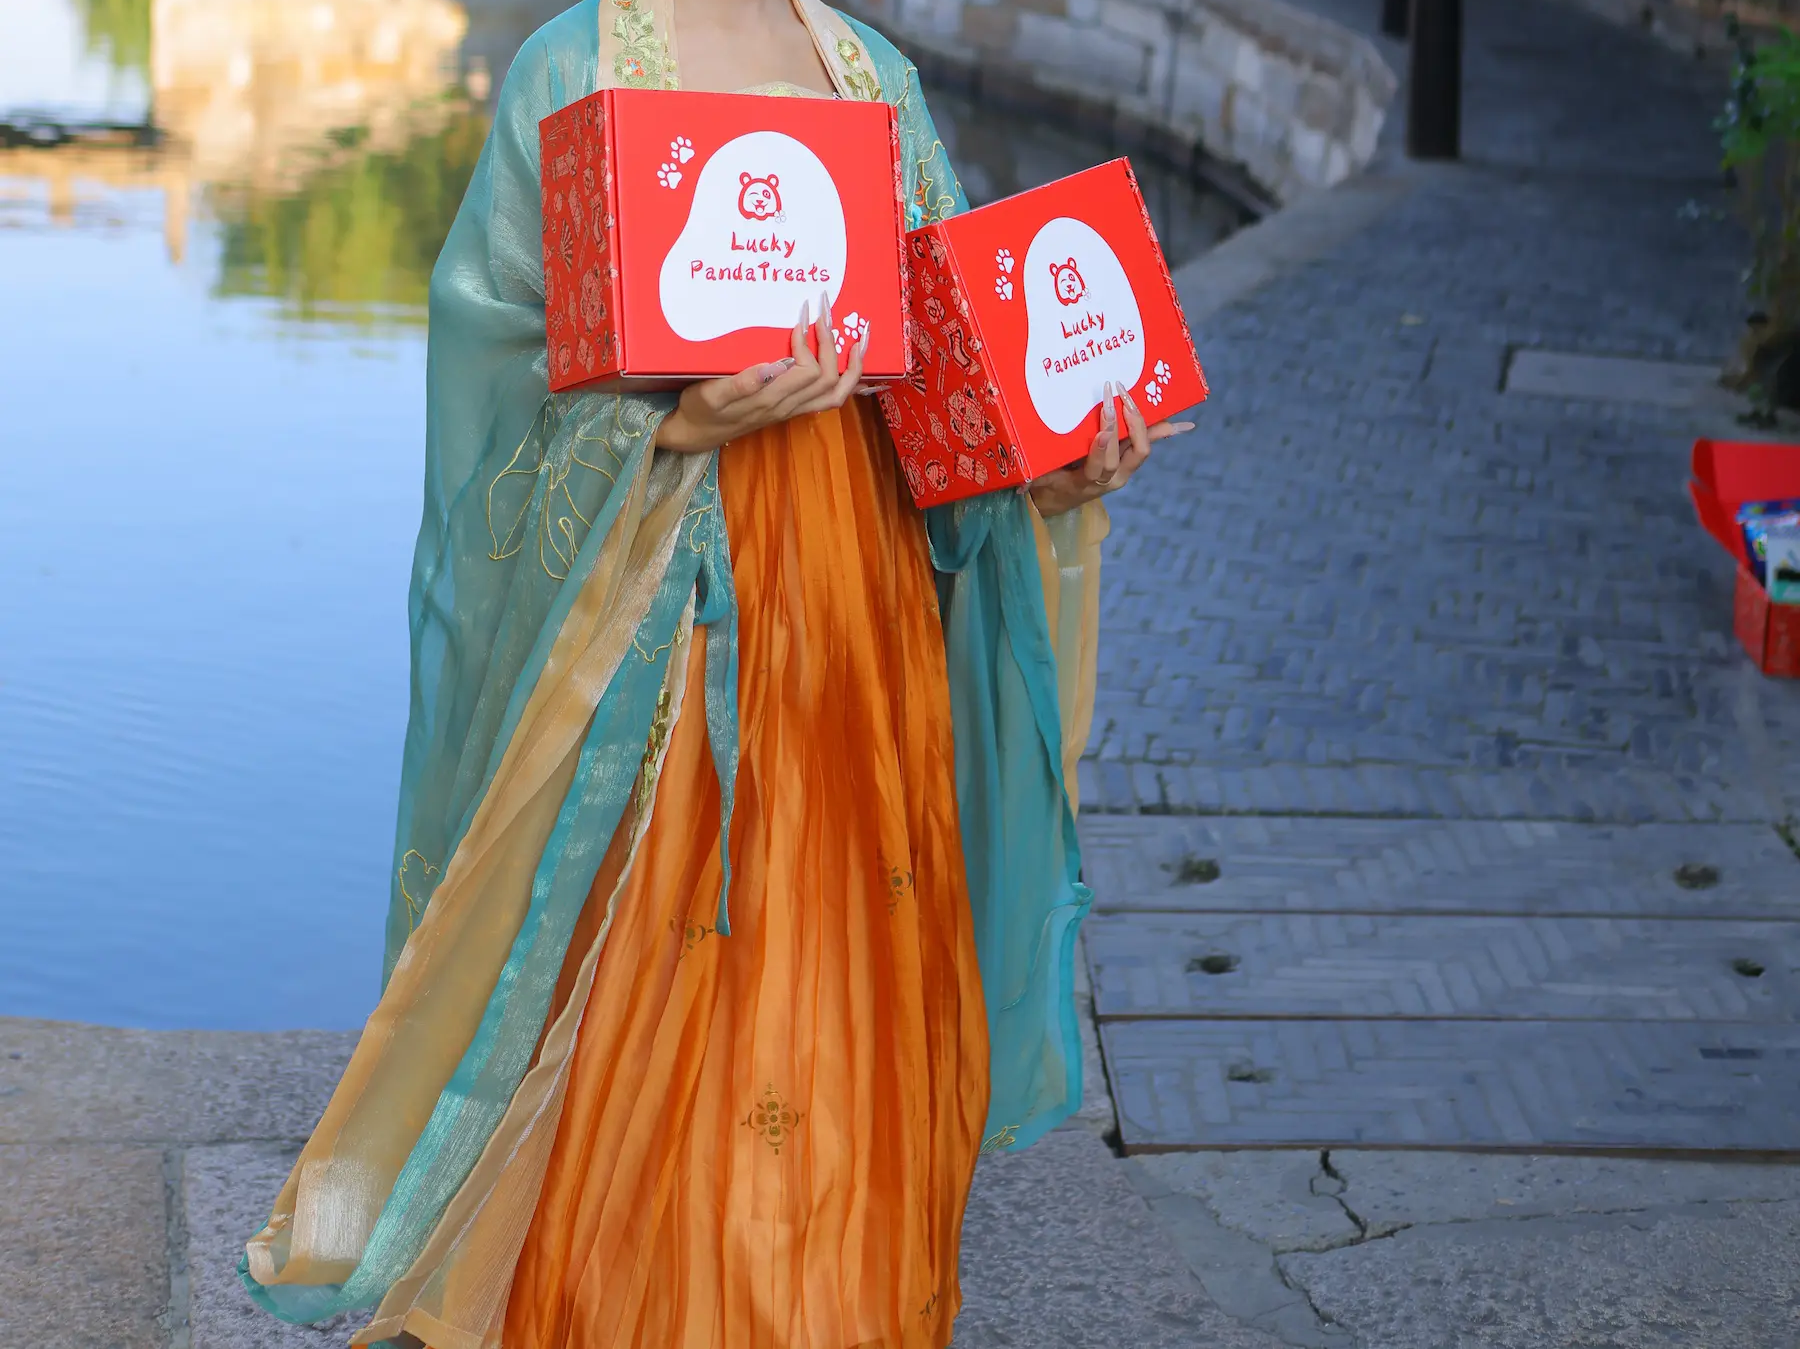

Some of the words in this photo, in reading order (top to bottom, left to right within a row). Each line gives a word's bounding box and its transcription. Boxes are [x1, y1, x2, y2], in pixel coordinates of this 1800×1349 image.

[731, 231, 796, 258] Lucky
[690, 260, 830, 282] PandaTreats
[1060, 311, 1105, 339] Lucky
[1042, 327, 1135, 377] PandaTreats
